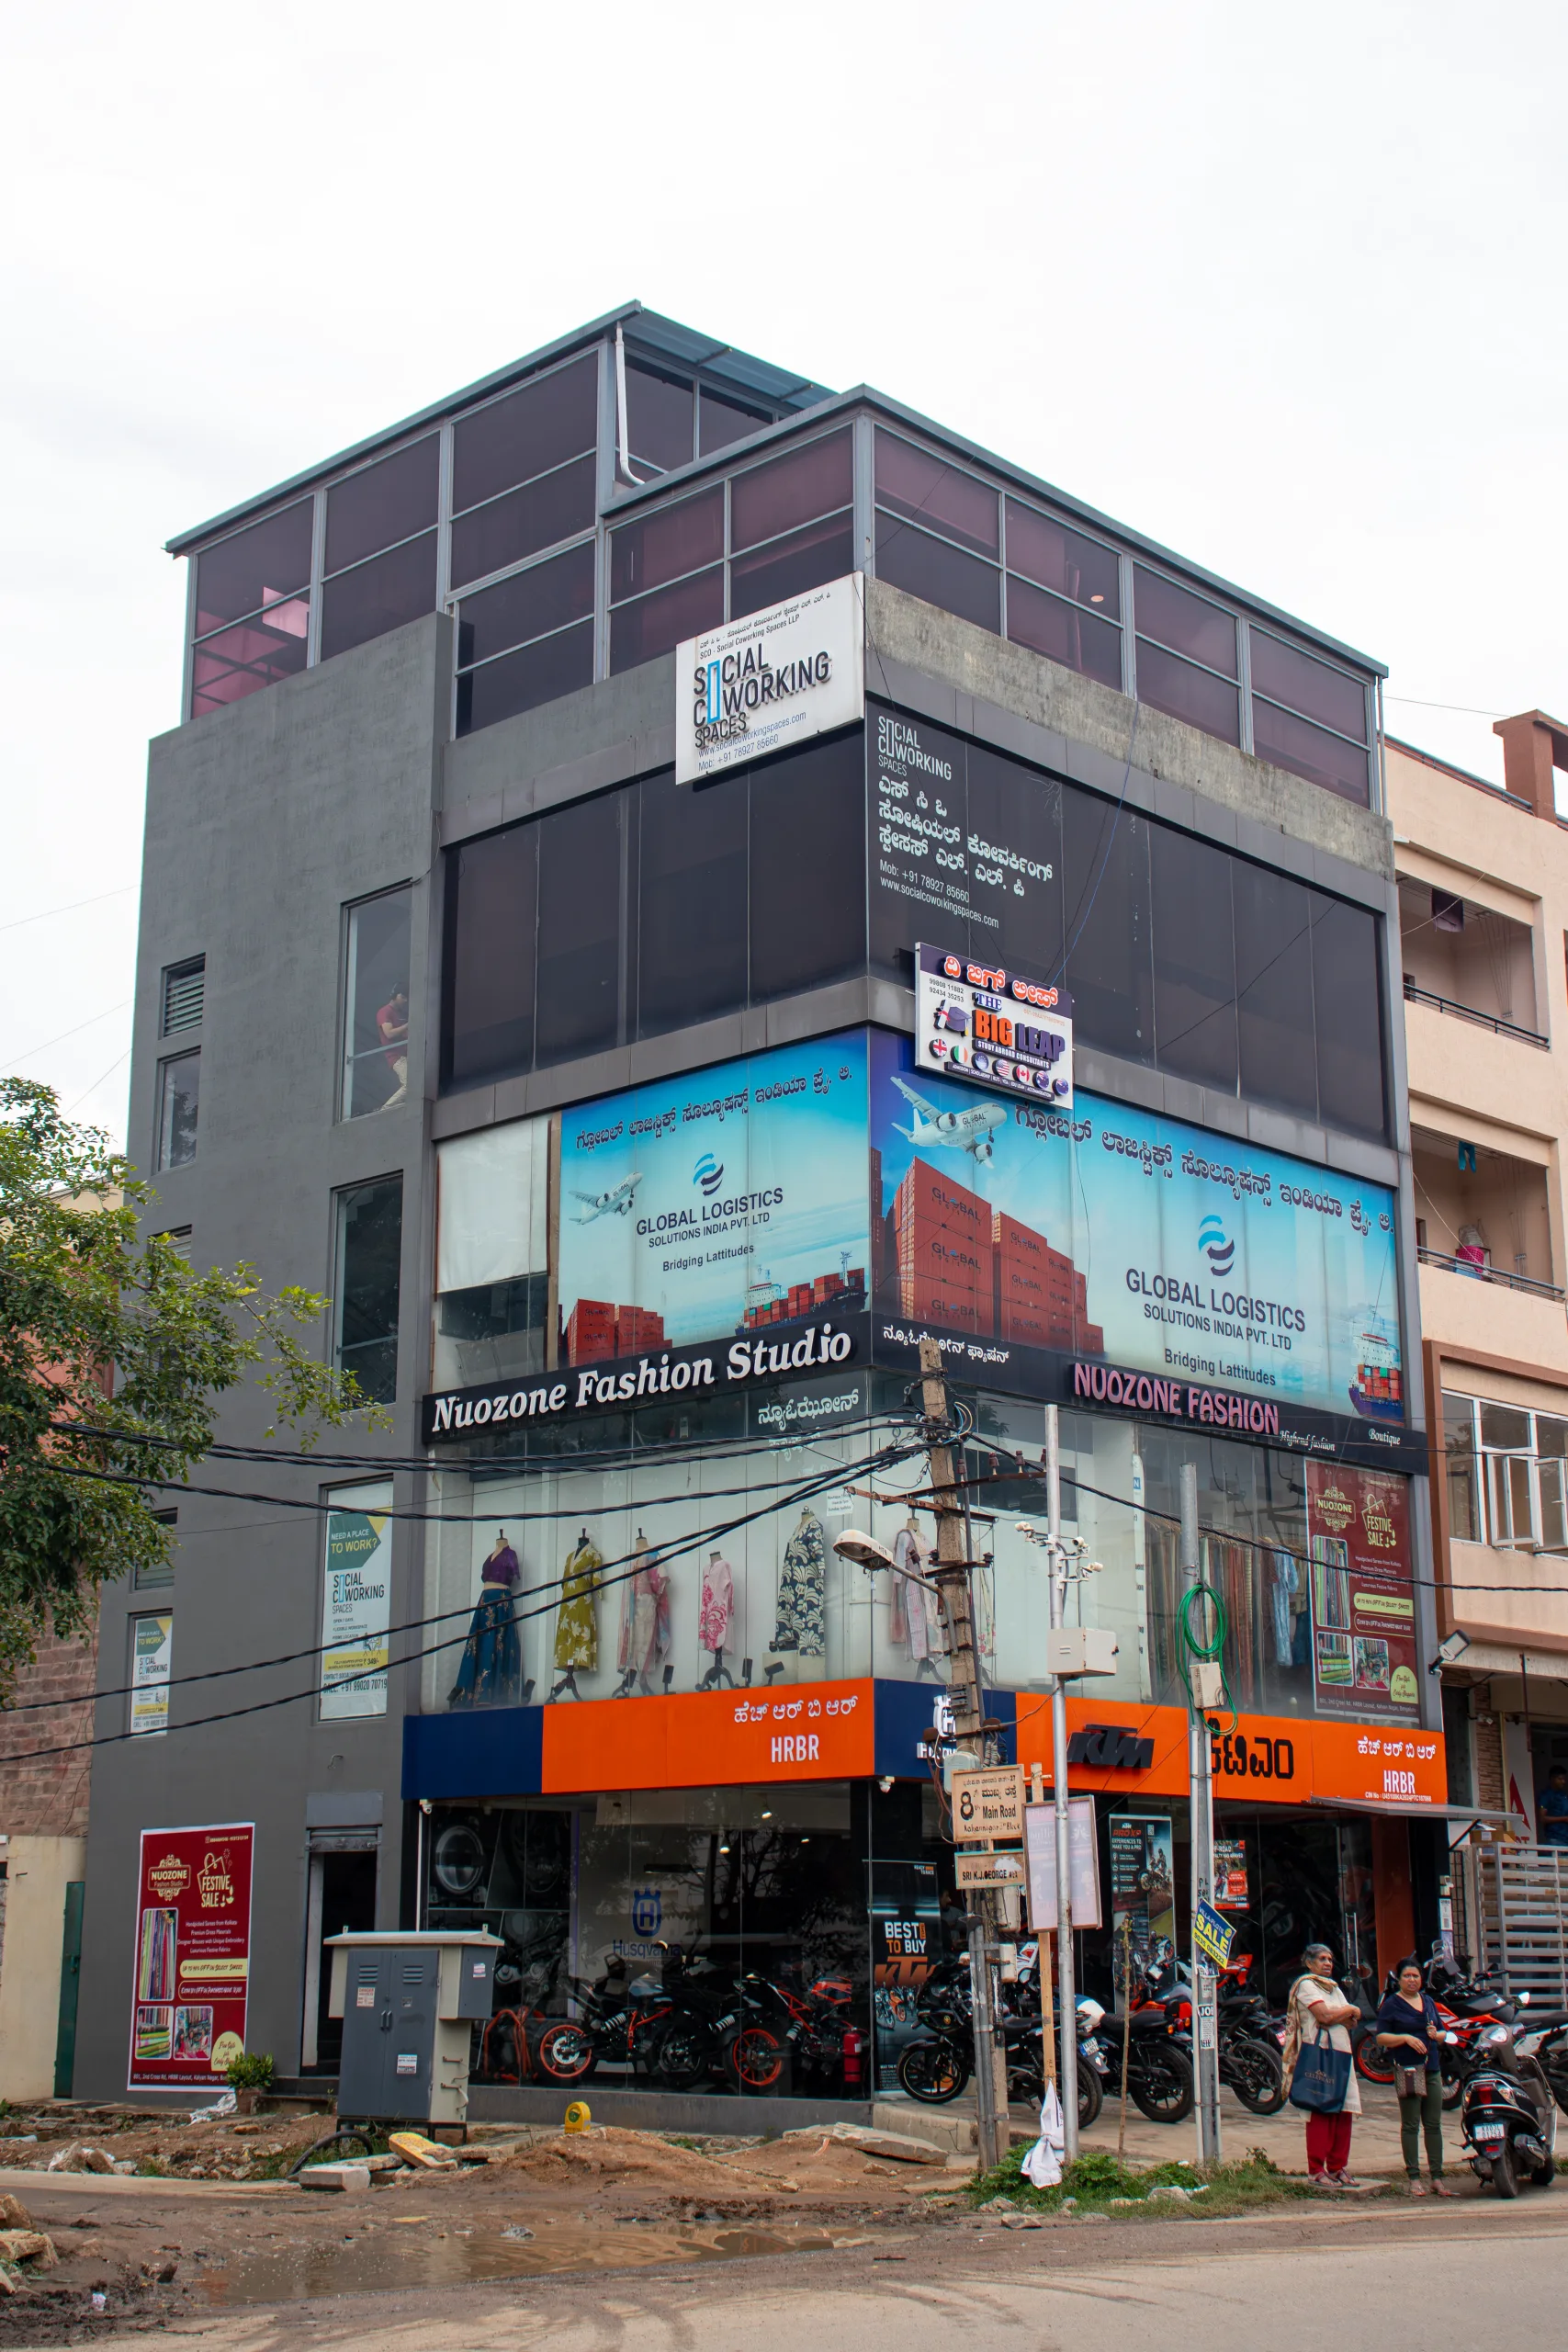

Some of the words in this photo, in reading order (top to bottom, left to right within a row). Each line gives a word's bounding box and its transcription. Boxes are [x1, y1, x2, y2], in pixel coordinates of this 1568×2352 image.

[700, 649, 711, 660] SCO
[717, 639, 734, 652] Social
[735, 627, 764, 645] Coworking
[766, 621, 786, 634] Spaces
[788, 614, 800, 625] LLP
[694, 712, 748, 748] SPACES
[698, 711, 807, 758] www.socialcoworkingspaces.com
[698, 757, 715, 772] Mob:
[717, 751, 731, 764] +91
[734, 742, 755, 759] 78927
[757, 733, 779, 750] 85660
[878, 755, 908, 776] SPACES
[880, 860, 899, 876] Mob:
[902, 866, 919, 884] +91
[921, 875, 944, 893] 78927
[946, 884, 970, 902] 85660
[976, 992, 1002, 1011] THE
[976, 1009, 1012, 1047] BIG
[1016, 1023, 1066, 1061] LEAP
[977, 1040, 996, 1054] STUDY
[996, 1046, 1016, 1058] ABROAD
[1016, 1049, 1049, 1069] CONSULTANTS
[636, 1208, 698, 1237] GLOBAL
[702, 1187, 784, 1222] LOGISTICS
[649, 1227, 701, 1249] SOLUTIONS
[703, 1222, 728, 1237] INDIA
[730, 1216, 750, 1231] PVT.
[752, 1212, 770, 1226] LTD
[662, 1255, 704, 1272] Bridging
[706, 1244, 755, 1264] Lattitudes
[1126, 1268, 1205, 1308] GLOBAL
[1211, 1288, 1304, 1332] LOGISTICS
[1144, 1303, 1211, 1332] SOLUTIONS
[1213, 1318, 1244, 1340] INDIA
[1246, 1327, 1269, 1345] PVT.
[1271, 1334, 1292, 1351] LTD
[432, 1383, 566, 1432] Nuozone
[575, 1354, 715, 1408] Fashion
[728, 1323, 852, 1380] Studio
[1165, 1348, 1215, 1376] Bridging
[1220, 1360, 1275, 1385] Lattitudes
[1073, 1362, 1181, 1417] NUOZONE
[1188, 1386, 1279, 1435] FASHION
[1369, 1428, 1400, 1446] Boutique
[1317, 1499, 1352, 1514] NUOZONE
[352, 1529, 369, 1537] PLACE
[1367, 1515, 1393, 1532] FESTIVE
[332, 1543, 344, 1555] TO
[345, 1538, 378, 1552] WORK?
[1367, 1531, 1383, 1547] SALE
[333, 1604, 353, 1614] SPACES
[342, 1683, 353, 1692] +91
[354, 1679, 369, 1690] 99020
[371, 1678, 388, 1689] 70719
[734, 1702, 770, 1724] ಹೆಚ್
[773, 1700, 805, 1720] ಆರ್
[807, 1700, 821, 1718] ಬಿ
[827, 1696, 859, 1716] ಆರ್
[771, 1735, 819, 1763] HRBR
[1066, 1724, 1156, 1770] KTM
[1358, 1735, 1382, 1755] ಹೆಚ್
[1383, 1742, 1404, 1757] ಆರ್
[1416, 1744, 1437, 1760] ಆರ್
[1383, 1770, 1415, 1793] HRBR
[983, 1806, 998, 1819] Main
[999, 1804, 1016, 1818] Road
[151, 1871, 187, 1880] NUOZONE
[202, 1875, 231, 1891] FESTIVE
[963, 1871, 972, 1882] SRI
[201, 1893, 219, 1907] SALE
[884, 1922, 919, 1939] BEST
[1196, 1914, 1229, 1955] SALE
[886, 1939, 901, 1953] TO
[904, 1939, 926, 1953] BUY
